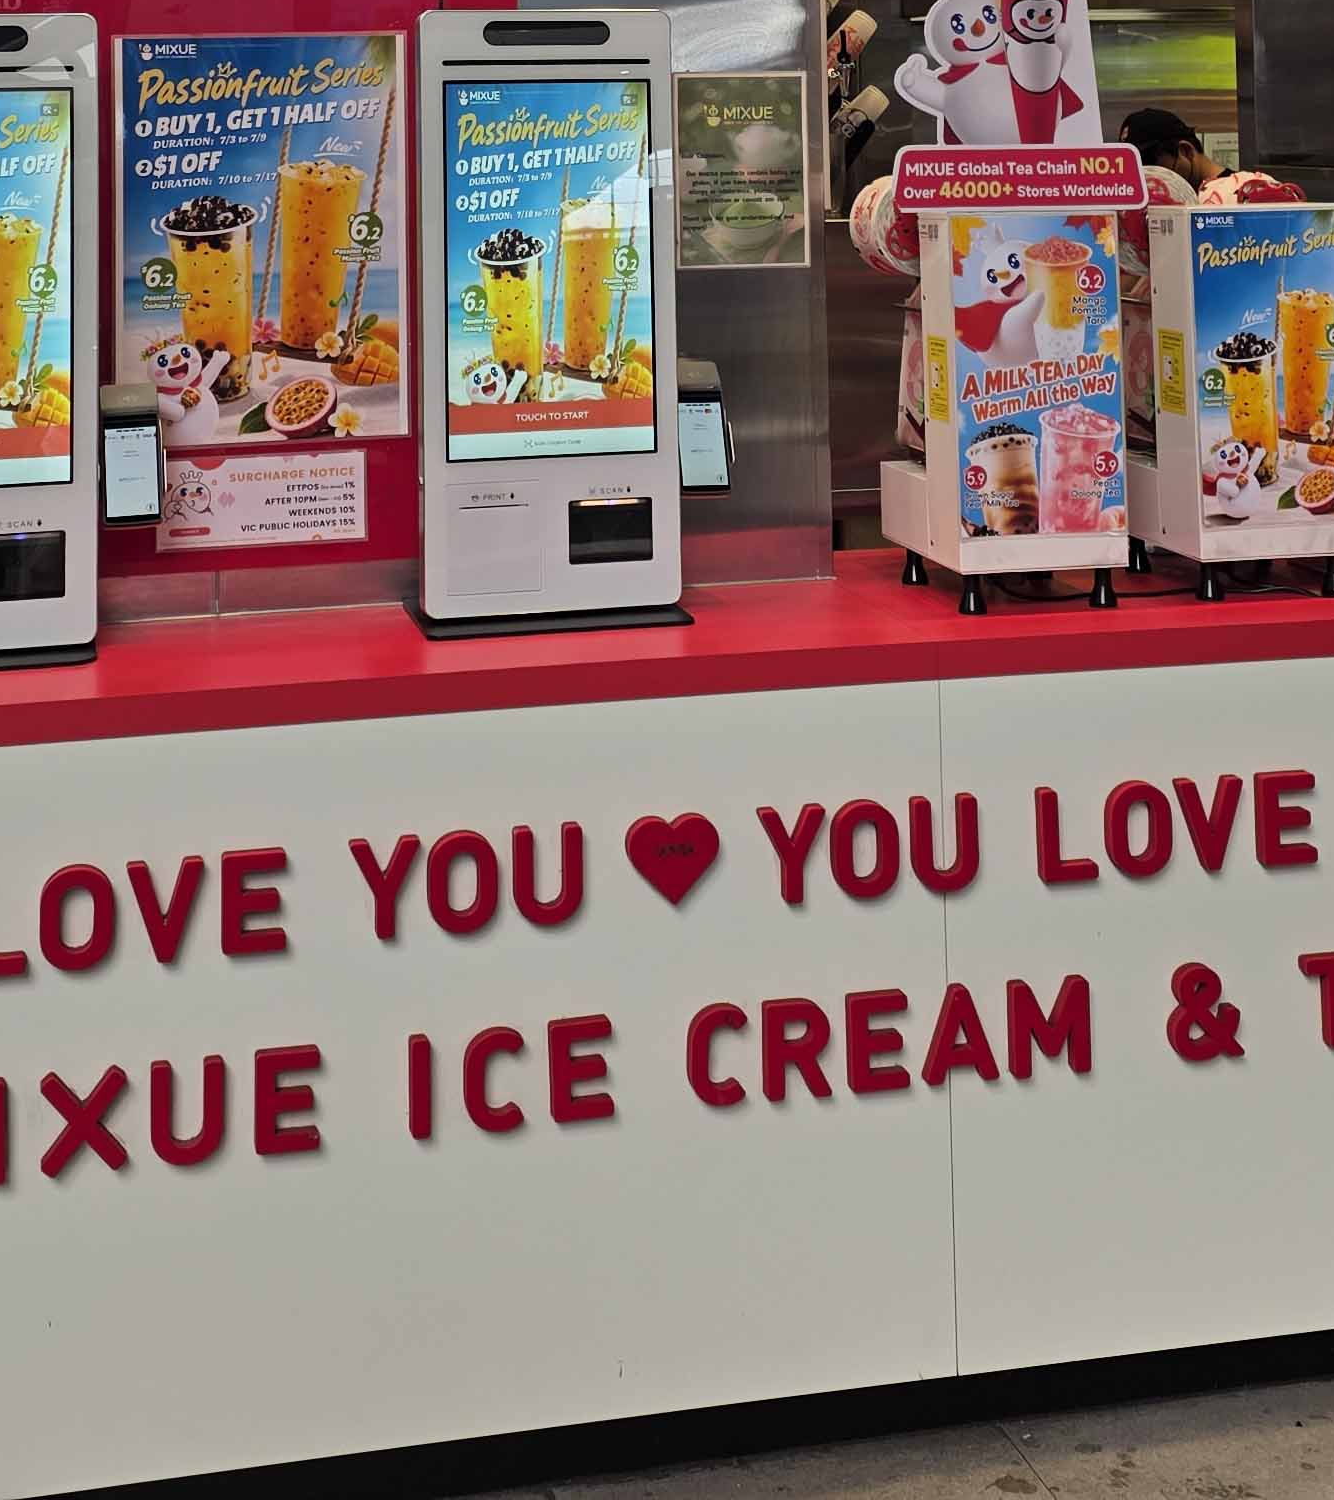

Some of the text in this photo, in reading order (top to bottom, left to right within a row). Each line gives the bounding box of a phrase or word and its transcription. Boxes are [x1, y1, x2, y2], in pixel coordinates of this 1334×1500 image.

[154, 43, 197, 55] MIXUE
[138, 58, 385, 116] Passionfruit Series
[469, 90, 501, 101] MIXUE
[154, 98, 380, 137] BUY 1, GET 1 HALF OFF
[723, 105, 773, 120] MIXUE
[457, 103, 639, 155] Passionfruit Series
[152, 136, 215, 150] DURATION:
[22, 153, 57, 175] OFF
[152, 150, 223, 179] $1 OFF
[470, 154, 506, 176] BUY
[522, 149, 555, 170] GET
[564, 144, 604, 165] HALF
[606, 141, 637, 161] OFF
[905, 156, 1125, 177] MIXUE Global Tea Chain NO.1
[151, 177, 213, 190] DURATION:
[218, 175, 240, 185] 7/10
[254, 173, 277, 183] 7/17
[903, 181, 1135, 199] Over 46000+ Stores Worldwide
[468, 188, 521, 213] $1 OFF
[1205, 216, 1235, 225] MIXUE
[1197, 235, 1298, 276] Passionfruit
[1073, 297, 1107, 306] Mango
[1071, 306, 1107, 315] Pomelo
[1086, 316, 1107, 325] Taro
[961, 353, 1105, 401] A MILK TEA A DAY
[973, 373, 1115, 423] Warm All the Way
[515, 411, 589, 422] TOUCH TO START
[229, 466, 356, 483] SURCHARGE NOTICE
[286, 483, 320, 492] EFTPOS
[344, 481, 356, 489] 1%
[265, 497, 292, 506] AFTER
[294, 495, 317, 504] 10PM
[342, 493, 356, 501] 5%
[288, 506, 356, 517] WEEKENDS 10%
[240, 518, 356, 533] VIC PUBLIC HOLIDAYS 15%
[349, 820, 585, 940] YOU
[756, 792, 981, 904] YOU
[1034, 770, 1319, 884] LOVE
[407, 1015, 616, 1140] ICE
[686, 975, 1094, 1108] CREAM
[1165, 962, 1246, 1062] &
